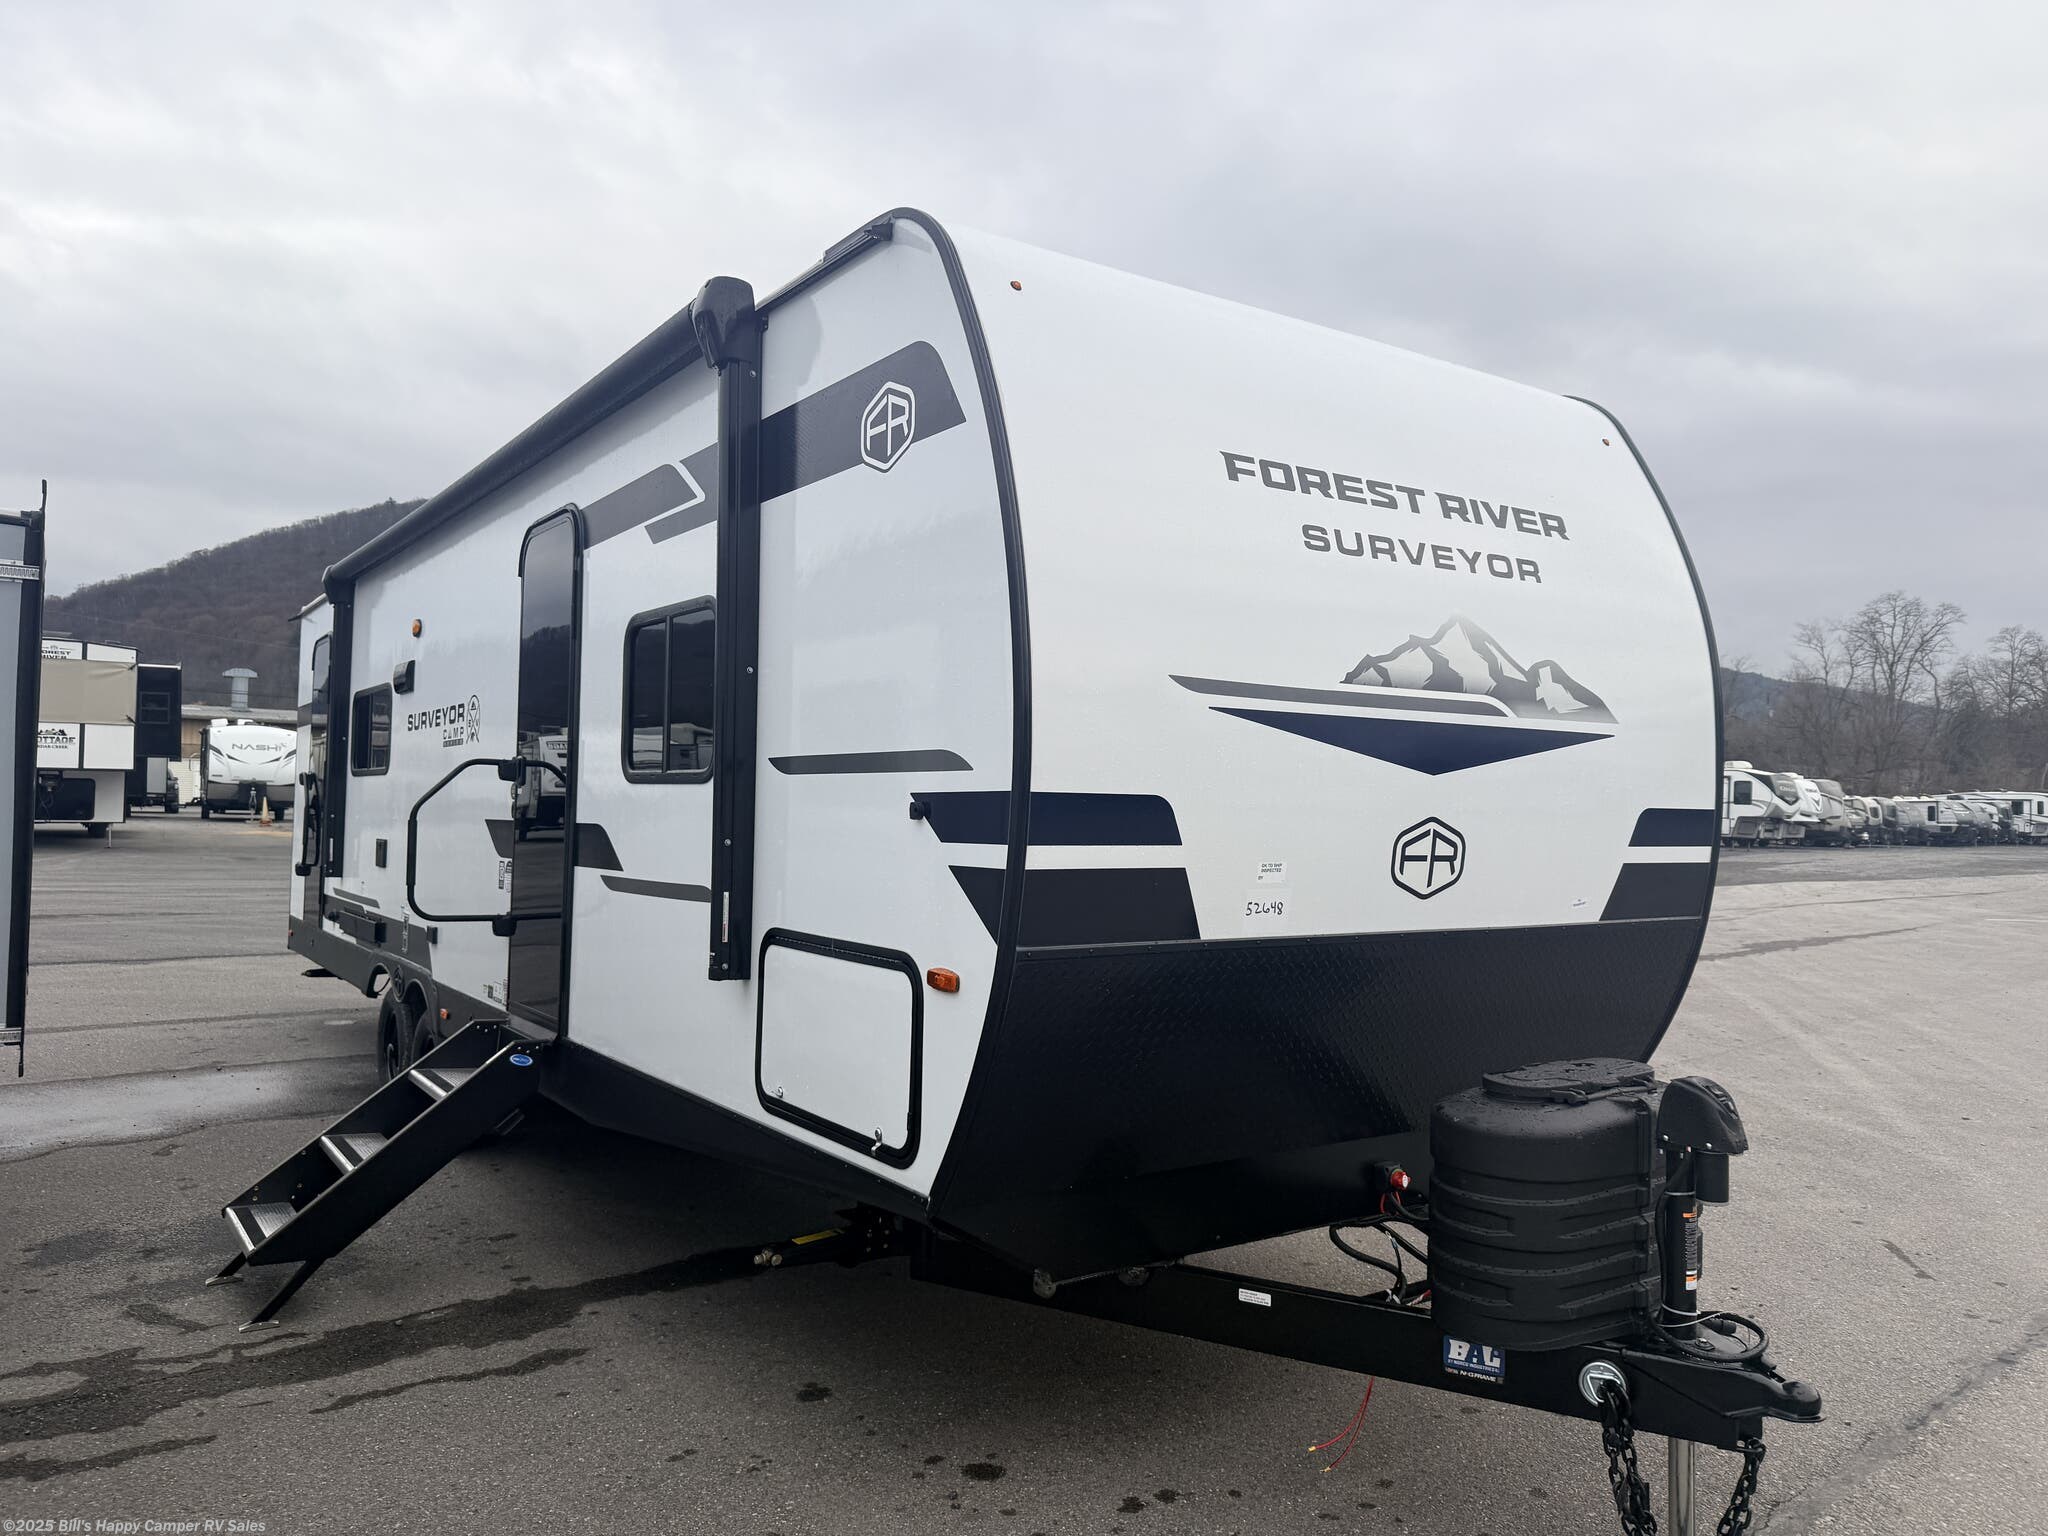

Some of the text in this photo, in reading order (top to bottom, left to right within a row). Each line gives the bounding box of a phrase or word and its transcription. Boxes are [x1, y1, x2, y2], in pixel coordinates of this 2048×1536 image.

[1219, 451, 1570, 541] FOREST RIVER
[1302, 524, 1542, 584] SURVEYOR
[407, 703, 465, 731] SURVEYOR
[37, 736, 76, 745] OTTAGE
[443, 726, 465, 739] CAMP
[1245, 900, 1284, 916] 52648
[1448, 1339, 1501, 1368] BAL
